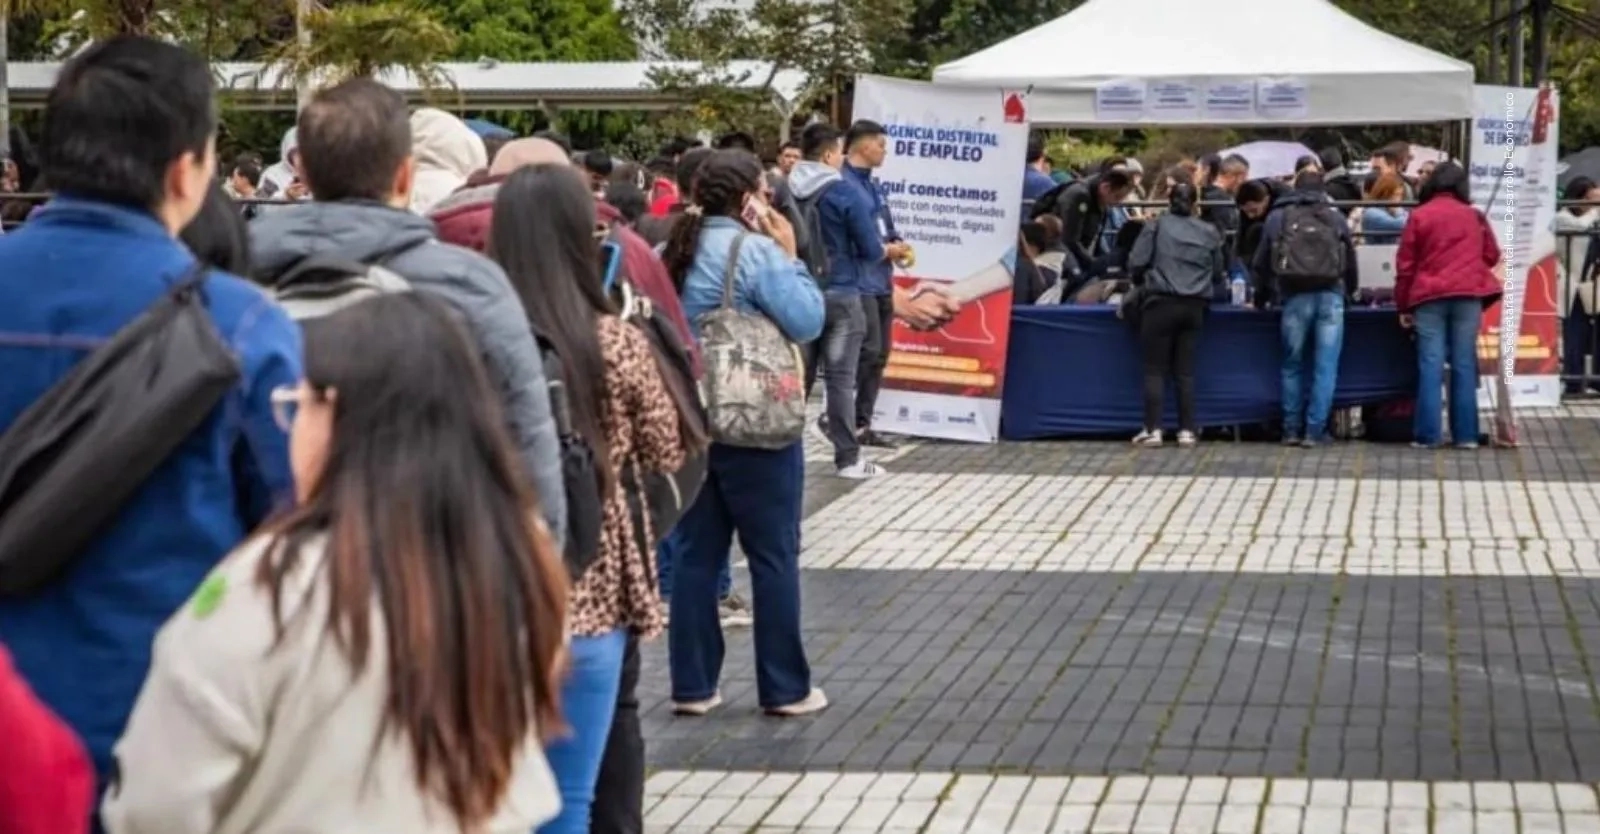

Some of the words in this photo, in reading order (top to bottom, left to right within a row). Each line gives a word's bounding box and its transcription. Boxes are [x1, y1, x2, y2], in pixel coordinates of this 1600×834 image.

[937, 129, 998, 146] DISTRITAL
[895, 140, 916, 157] DE
[920, 142, 983, 162] EMPLEO
[909, 181, 997, 202] conectamos
